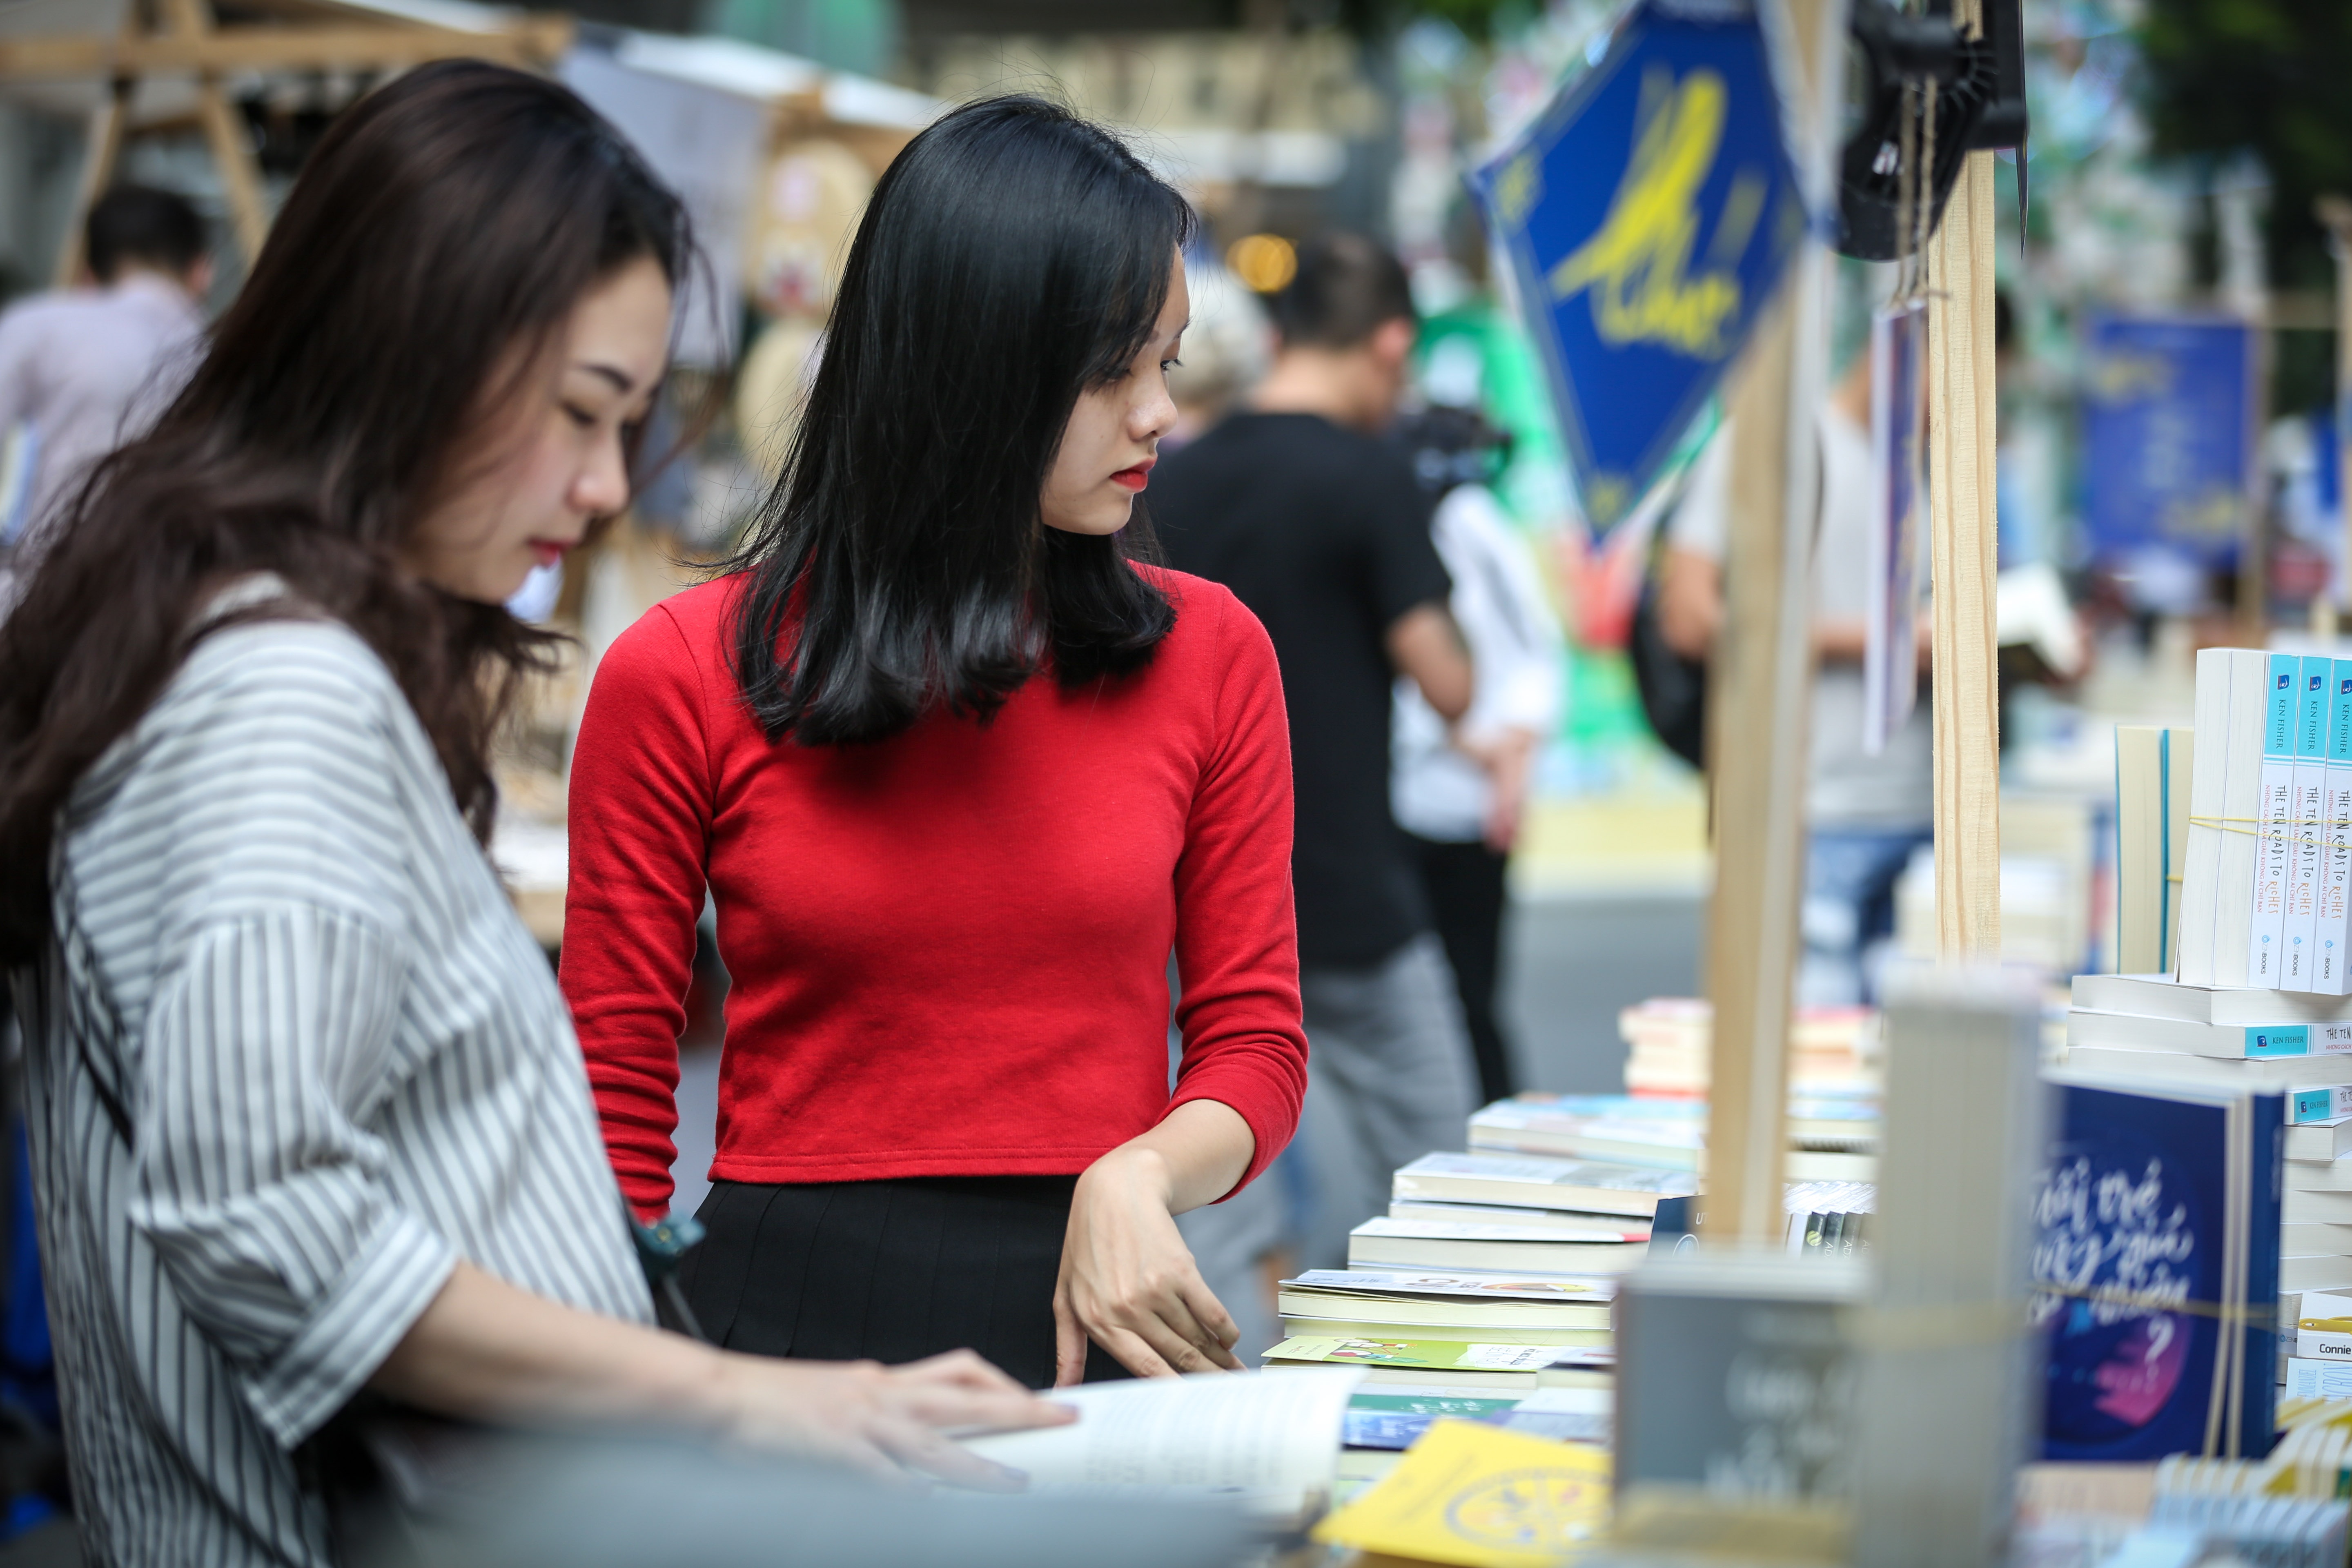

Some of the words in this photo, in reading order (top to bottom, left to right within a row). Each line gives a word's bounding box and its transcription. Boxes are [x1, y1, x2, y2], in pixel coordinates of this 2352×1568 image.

[2276, 719, 2285, 748] FISHER
[2307, 721, 2316, 751] FISHER
[2339, 724, 2348, 754] FISHER
[2275, 785, 2287, 802] THE
[2307, 787, 2319, 804] THE
[2338, 790, 2350, 807] THE
[2272, 807, 2286, 824] TEN
[2304, 808, 2318, 826] TEN
[2336, 812, 2349, 829] TEN
[2268, 830, 2284, 860] ROADS
[2300, 831, 2316, 862] ROADS
[2332, 835, 2348, 865] ROADS
[2270, 865, 2282, 876] TO
[2301, 867, 2313, 878] TO
[2333, 870, 2345, 881] TO
[2326, 1027, 2337, 1040] THE
[2340, 1026, 2351, 1040] TEN
[2319, 1343, 2351, 1354] Connie
